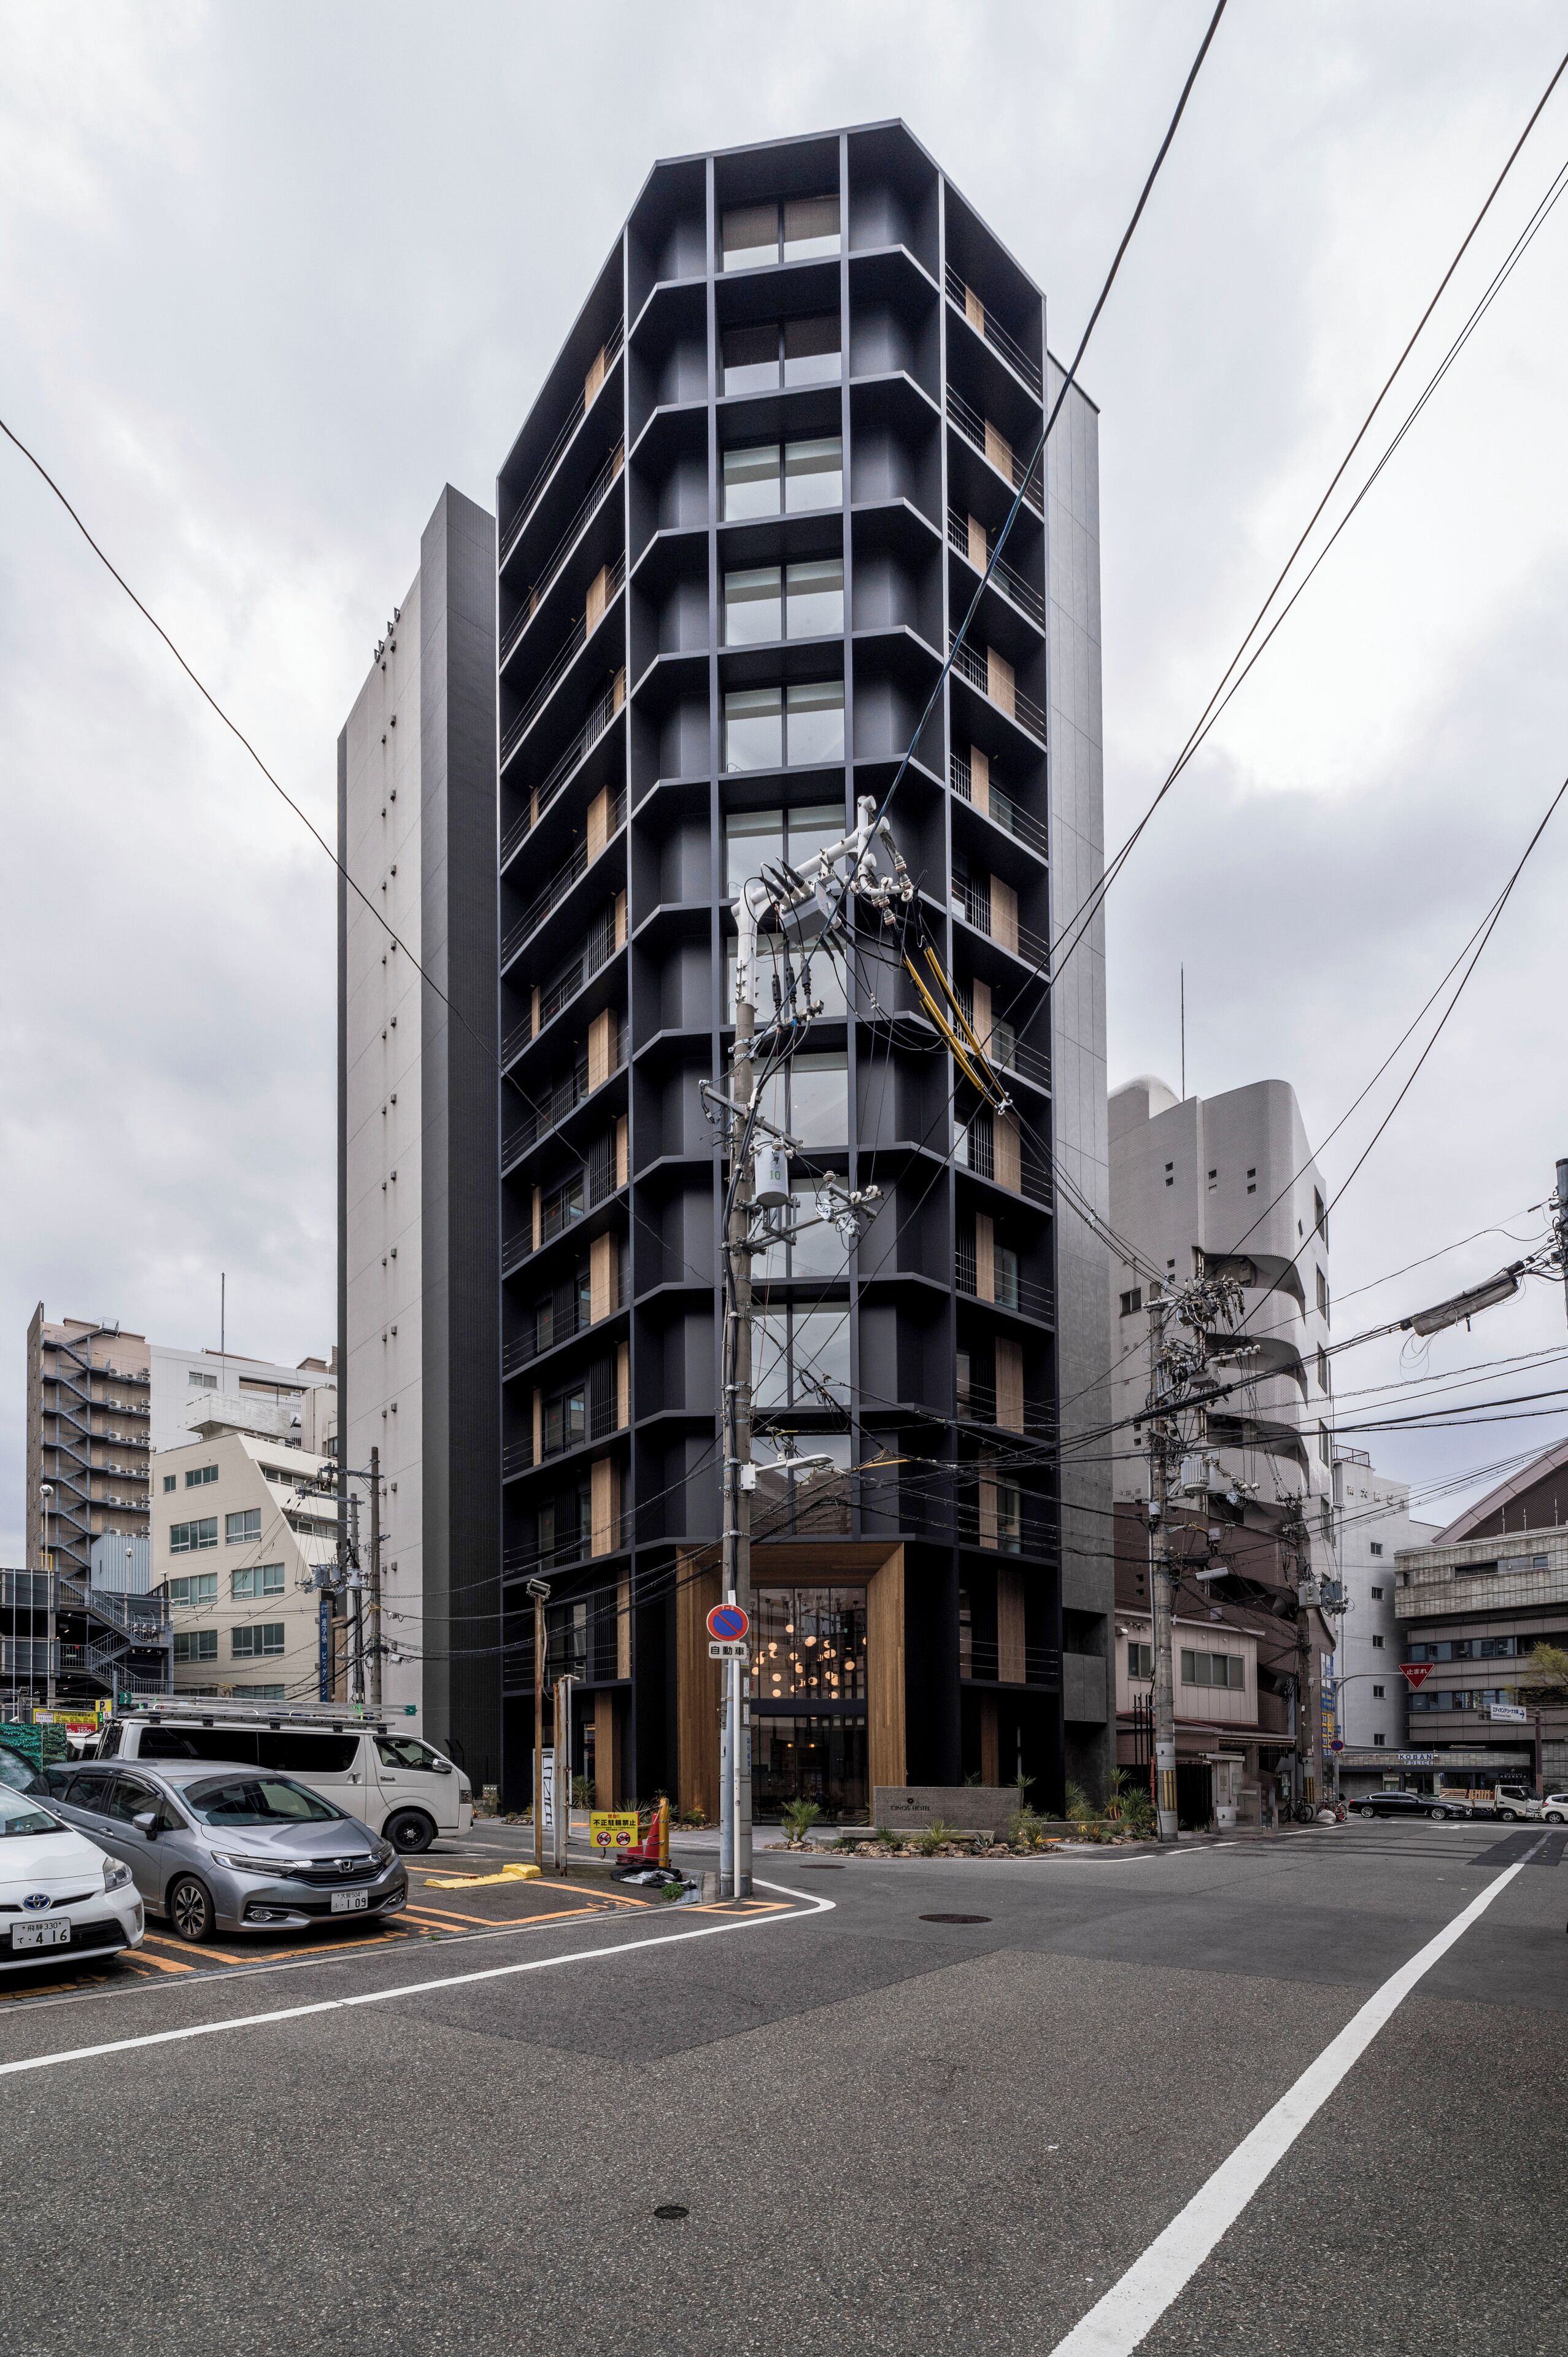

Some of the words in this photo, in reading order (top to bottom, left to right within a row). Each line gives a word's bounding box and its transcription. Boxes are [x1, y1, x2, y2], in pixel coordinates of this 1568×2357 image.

[711, 1646, 744, 1655] 自動車
[99, 1701, 105, 1711] P
